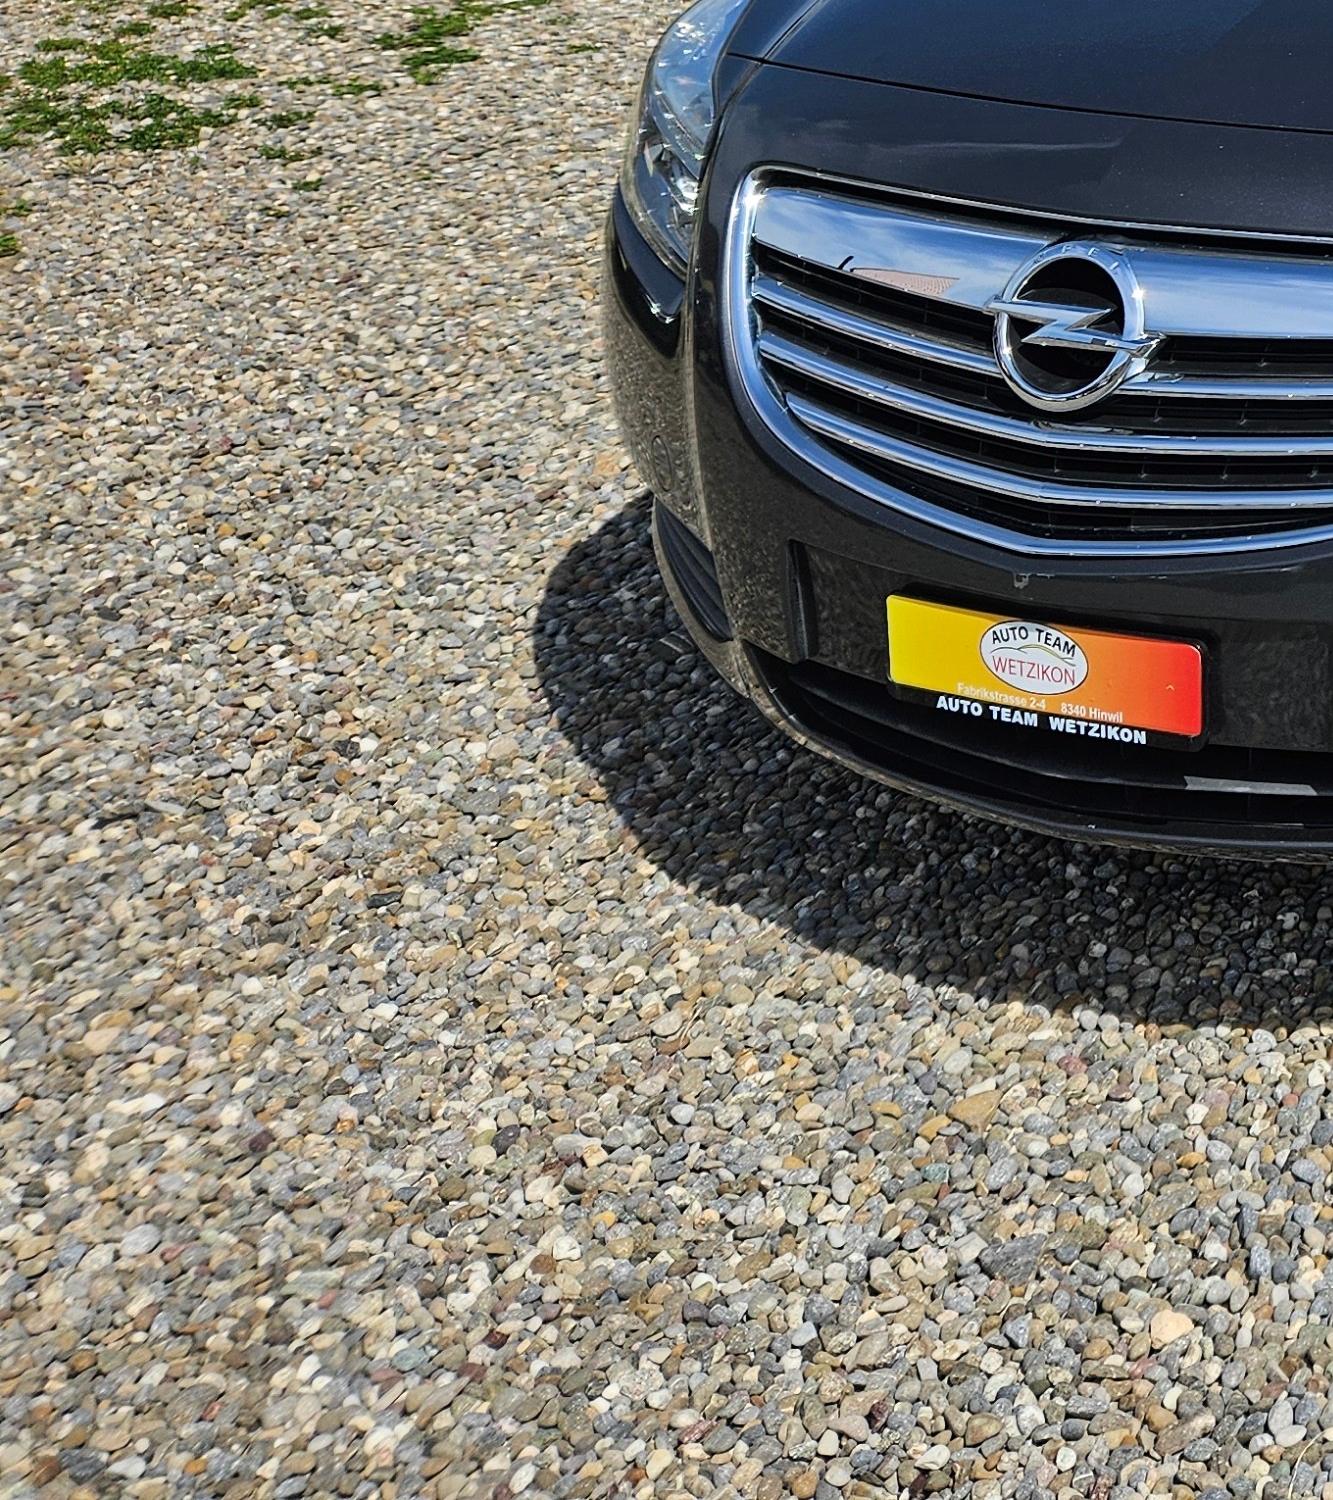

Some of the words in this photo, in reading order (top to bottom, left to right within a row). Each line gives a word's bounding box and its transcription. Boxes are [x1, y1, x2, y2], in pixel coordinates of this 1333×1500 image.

[991, 625, 1029, 645] AUTO
[1035, 627, 1076, 658] TEAM
[991, 655, 1076, 686] WETZIKON
[936, 695, 983, 717] AUTO
[988, 705, 1038, 728] TEAM
[1048, 716, 1147, 745] WETZIKON
[957, 682, 1027, 707] Fabrikstrasse
[1029, 697, 1046, 710] 2-4
[1060, 703, 1086, 717] 8340
[1089, 707, 1123, 723] Hinwil
